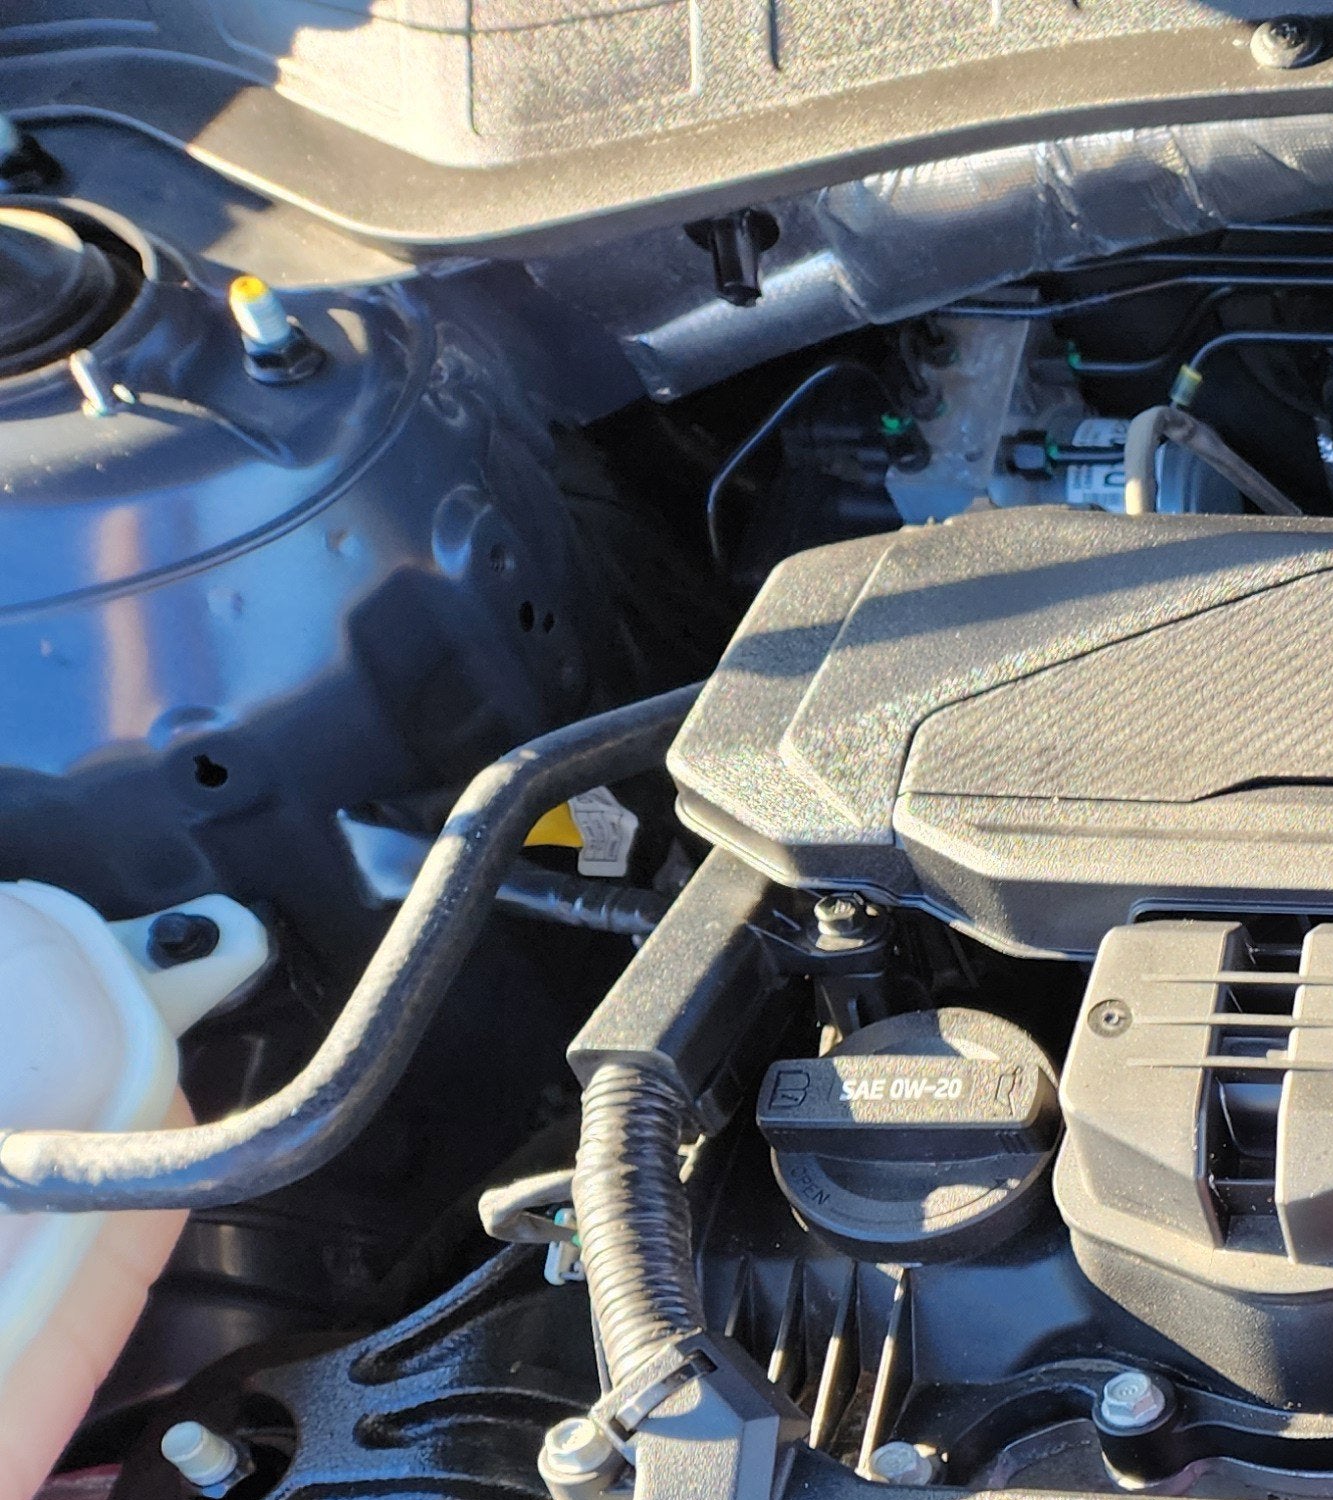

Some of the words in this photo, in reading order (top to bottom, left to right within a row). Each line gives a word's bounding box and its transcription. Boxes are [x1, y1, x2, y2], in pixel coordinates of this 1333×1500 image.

[840, 1078, 886, 1100] SAE
[890, 1078, 962, 1099] 0W-20
[790, 1166, 830, 1205] OPEN
